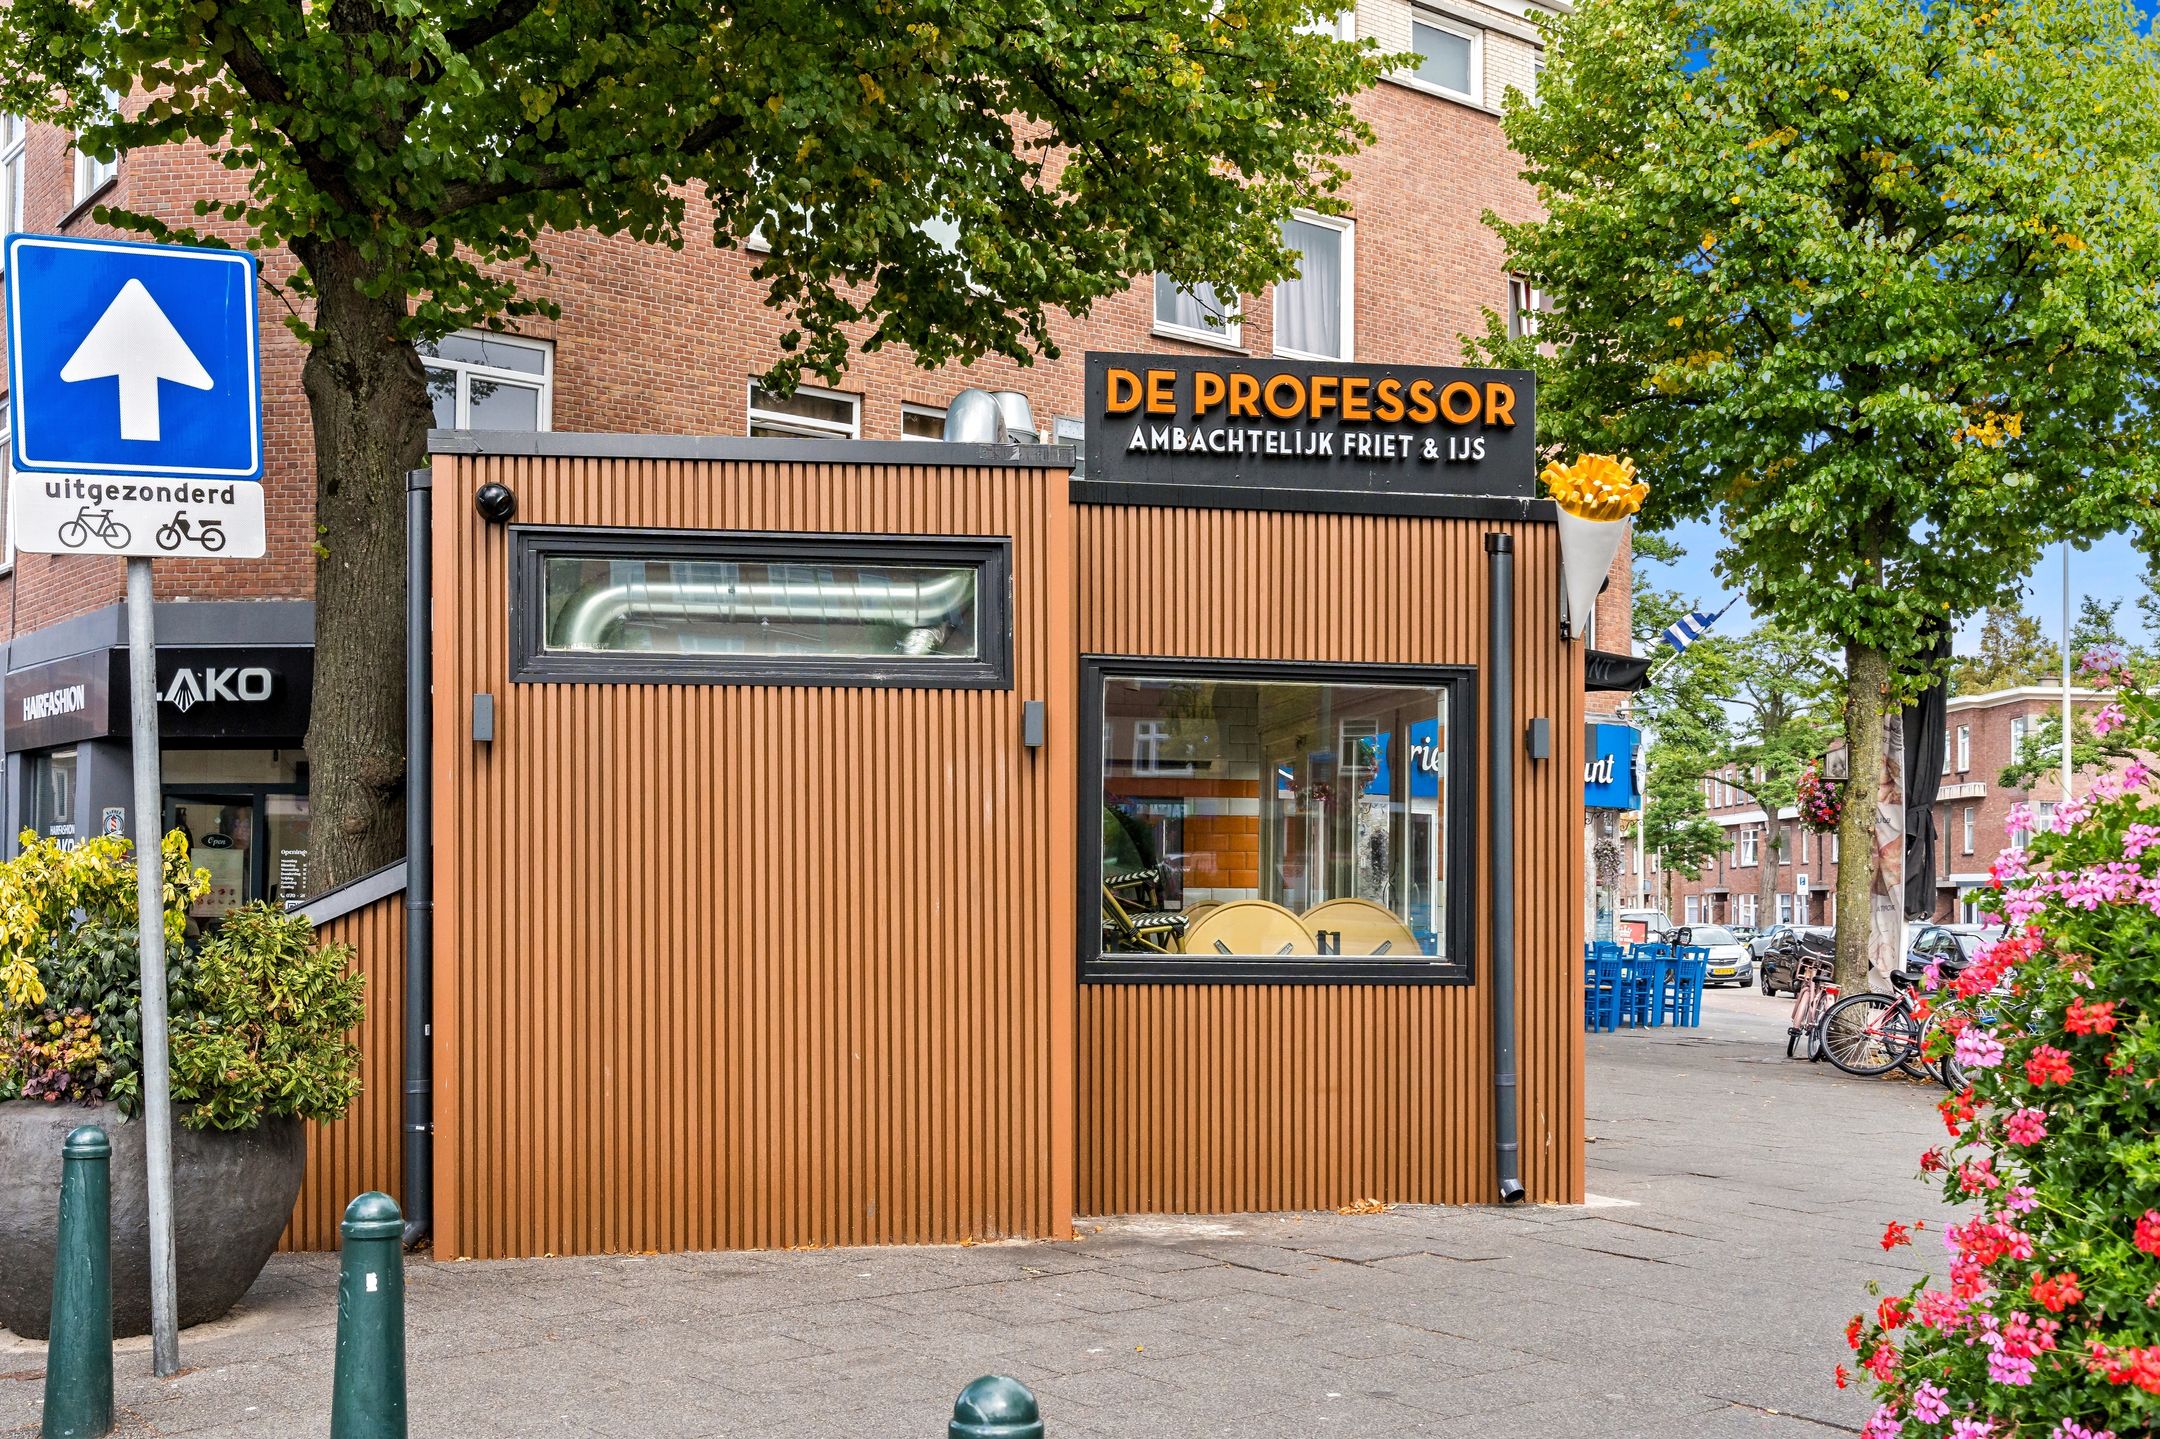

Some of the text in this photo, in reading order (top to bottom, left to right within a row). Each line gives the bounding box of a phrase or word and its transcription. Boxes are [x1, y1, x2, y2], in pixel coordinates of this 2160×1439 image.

[1107, 367, 1516, 426] DE PROFESSOR
[1128, 425, 1486, 461] AMBACHTELIJK FRIET & IJS
[45, 478, 235, 506] uitgezonderd
[23, 684, 85, 722] HAIRFASHION
[156, 667, 272, 713] AKO
[207, 837, 226, 847] Open
